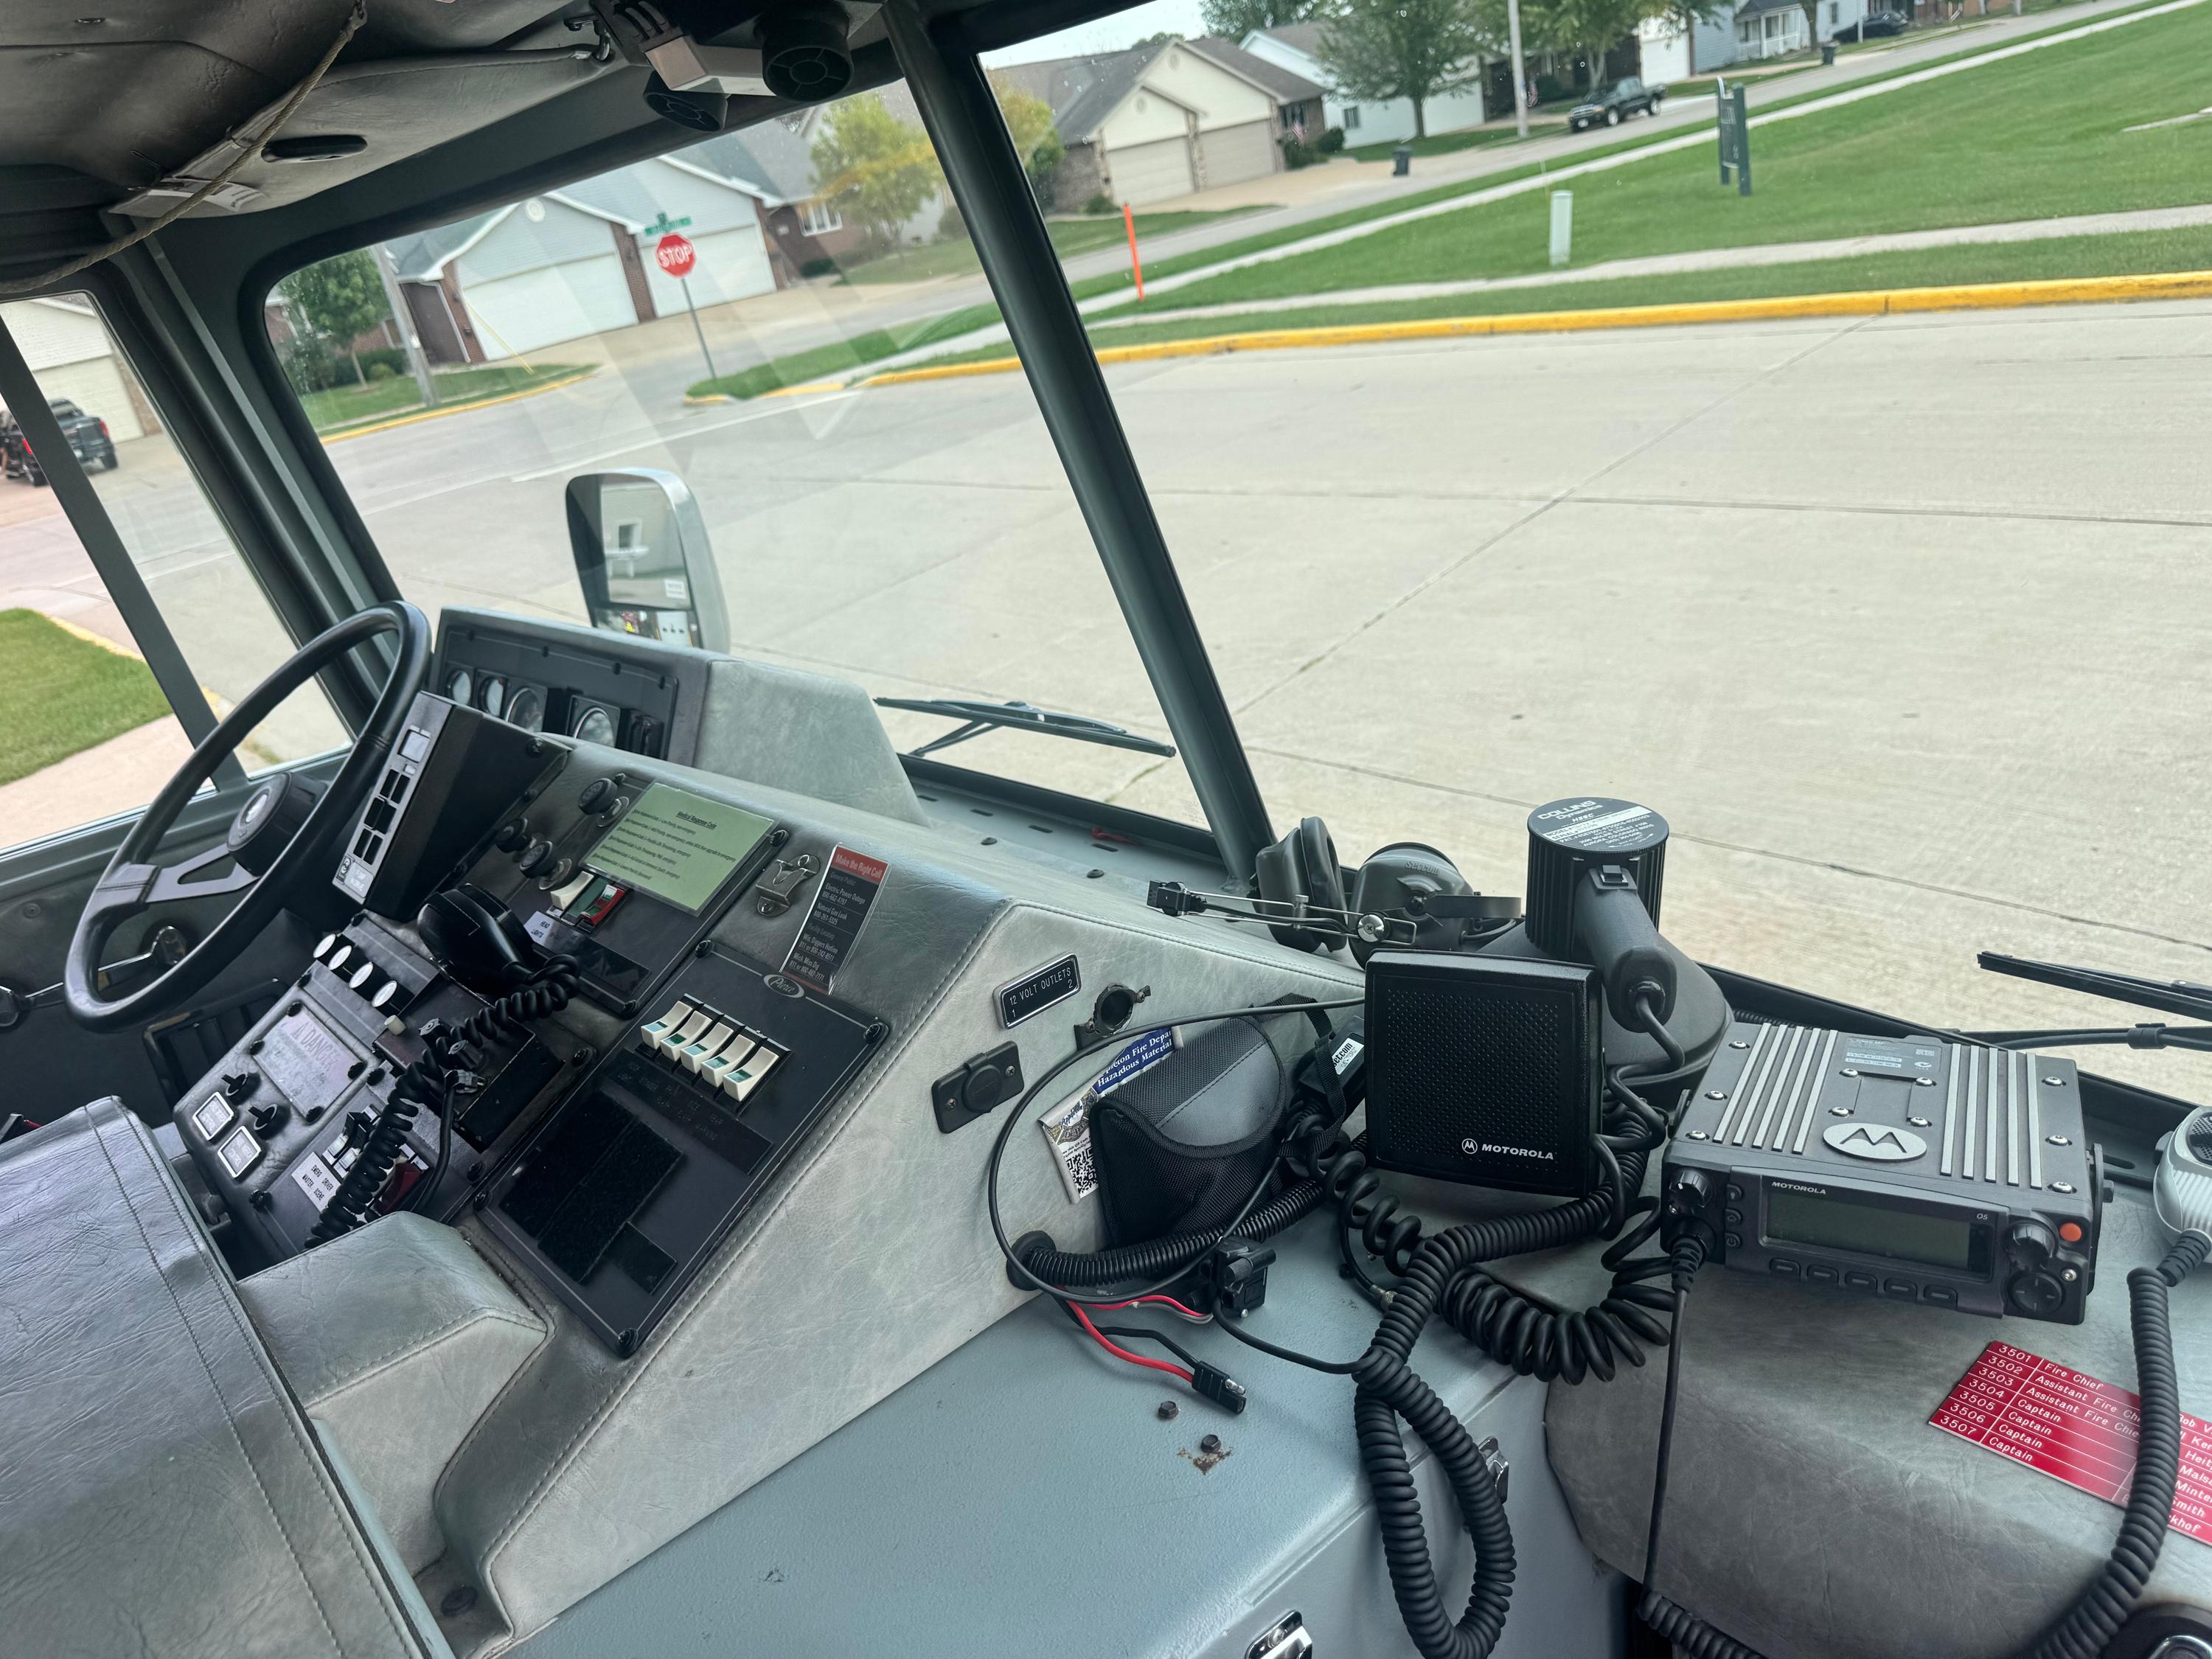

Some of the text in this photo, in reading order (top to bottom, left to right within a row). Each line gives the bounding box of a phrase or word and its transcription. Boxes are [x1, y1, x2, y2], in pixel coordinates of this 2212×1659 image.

[658, 244, 692, 268] STOP
[1537, 801, 1596, 819] COLLINS
[835, 855, 849, 867] Make
[858, 862, 872, 875] Right
[872, 866, 883, 878] Call
[770, 977, 795, 992] Pierce
[1009, 967, 1071, 1006] 12 VOLT OUTLETS
[1068, 979, 1073, 989] 2
[1012, 1009, 1016, 1018] 1
[1105, 1054, 1130, 1074] eton
[1132, 1043, 1147, 1057] Fire
[1097, 1059, 1140, 1087] Hazardous
[1481, 1144, 1554, 1160] MOTOROLA
[1771, 1181, 1826, 1194] MOTOROLA
[1988, 1355, 2023, 1375] 3502
[1999, 1345, 2031, 1363] 3501
[1978, 1367, 2014, 1386] 3503
[2045, 1363, 2104, 1391] Fire Chief
[1969, 1378, 2062, 1422] 3504 Captain
[2035, 1375, 2088, 1401] Assistant
[2093, 1397, 2118, 1413] Fire
[1960, 1391, 2052, 1435] 3505 Captain
[2026, 1387, 2140, 1437] Assistant Fire Chie
[1950, 1402, 2042, 1449] 3506 Captain
[1940, 1415, 2034, 1461] 3507 Captain
[2169, 1514, 2201, 1533] khof
